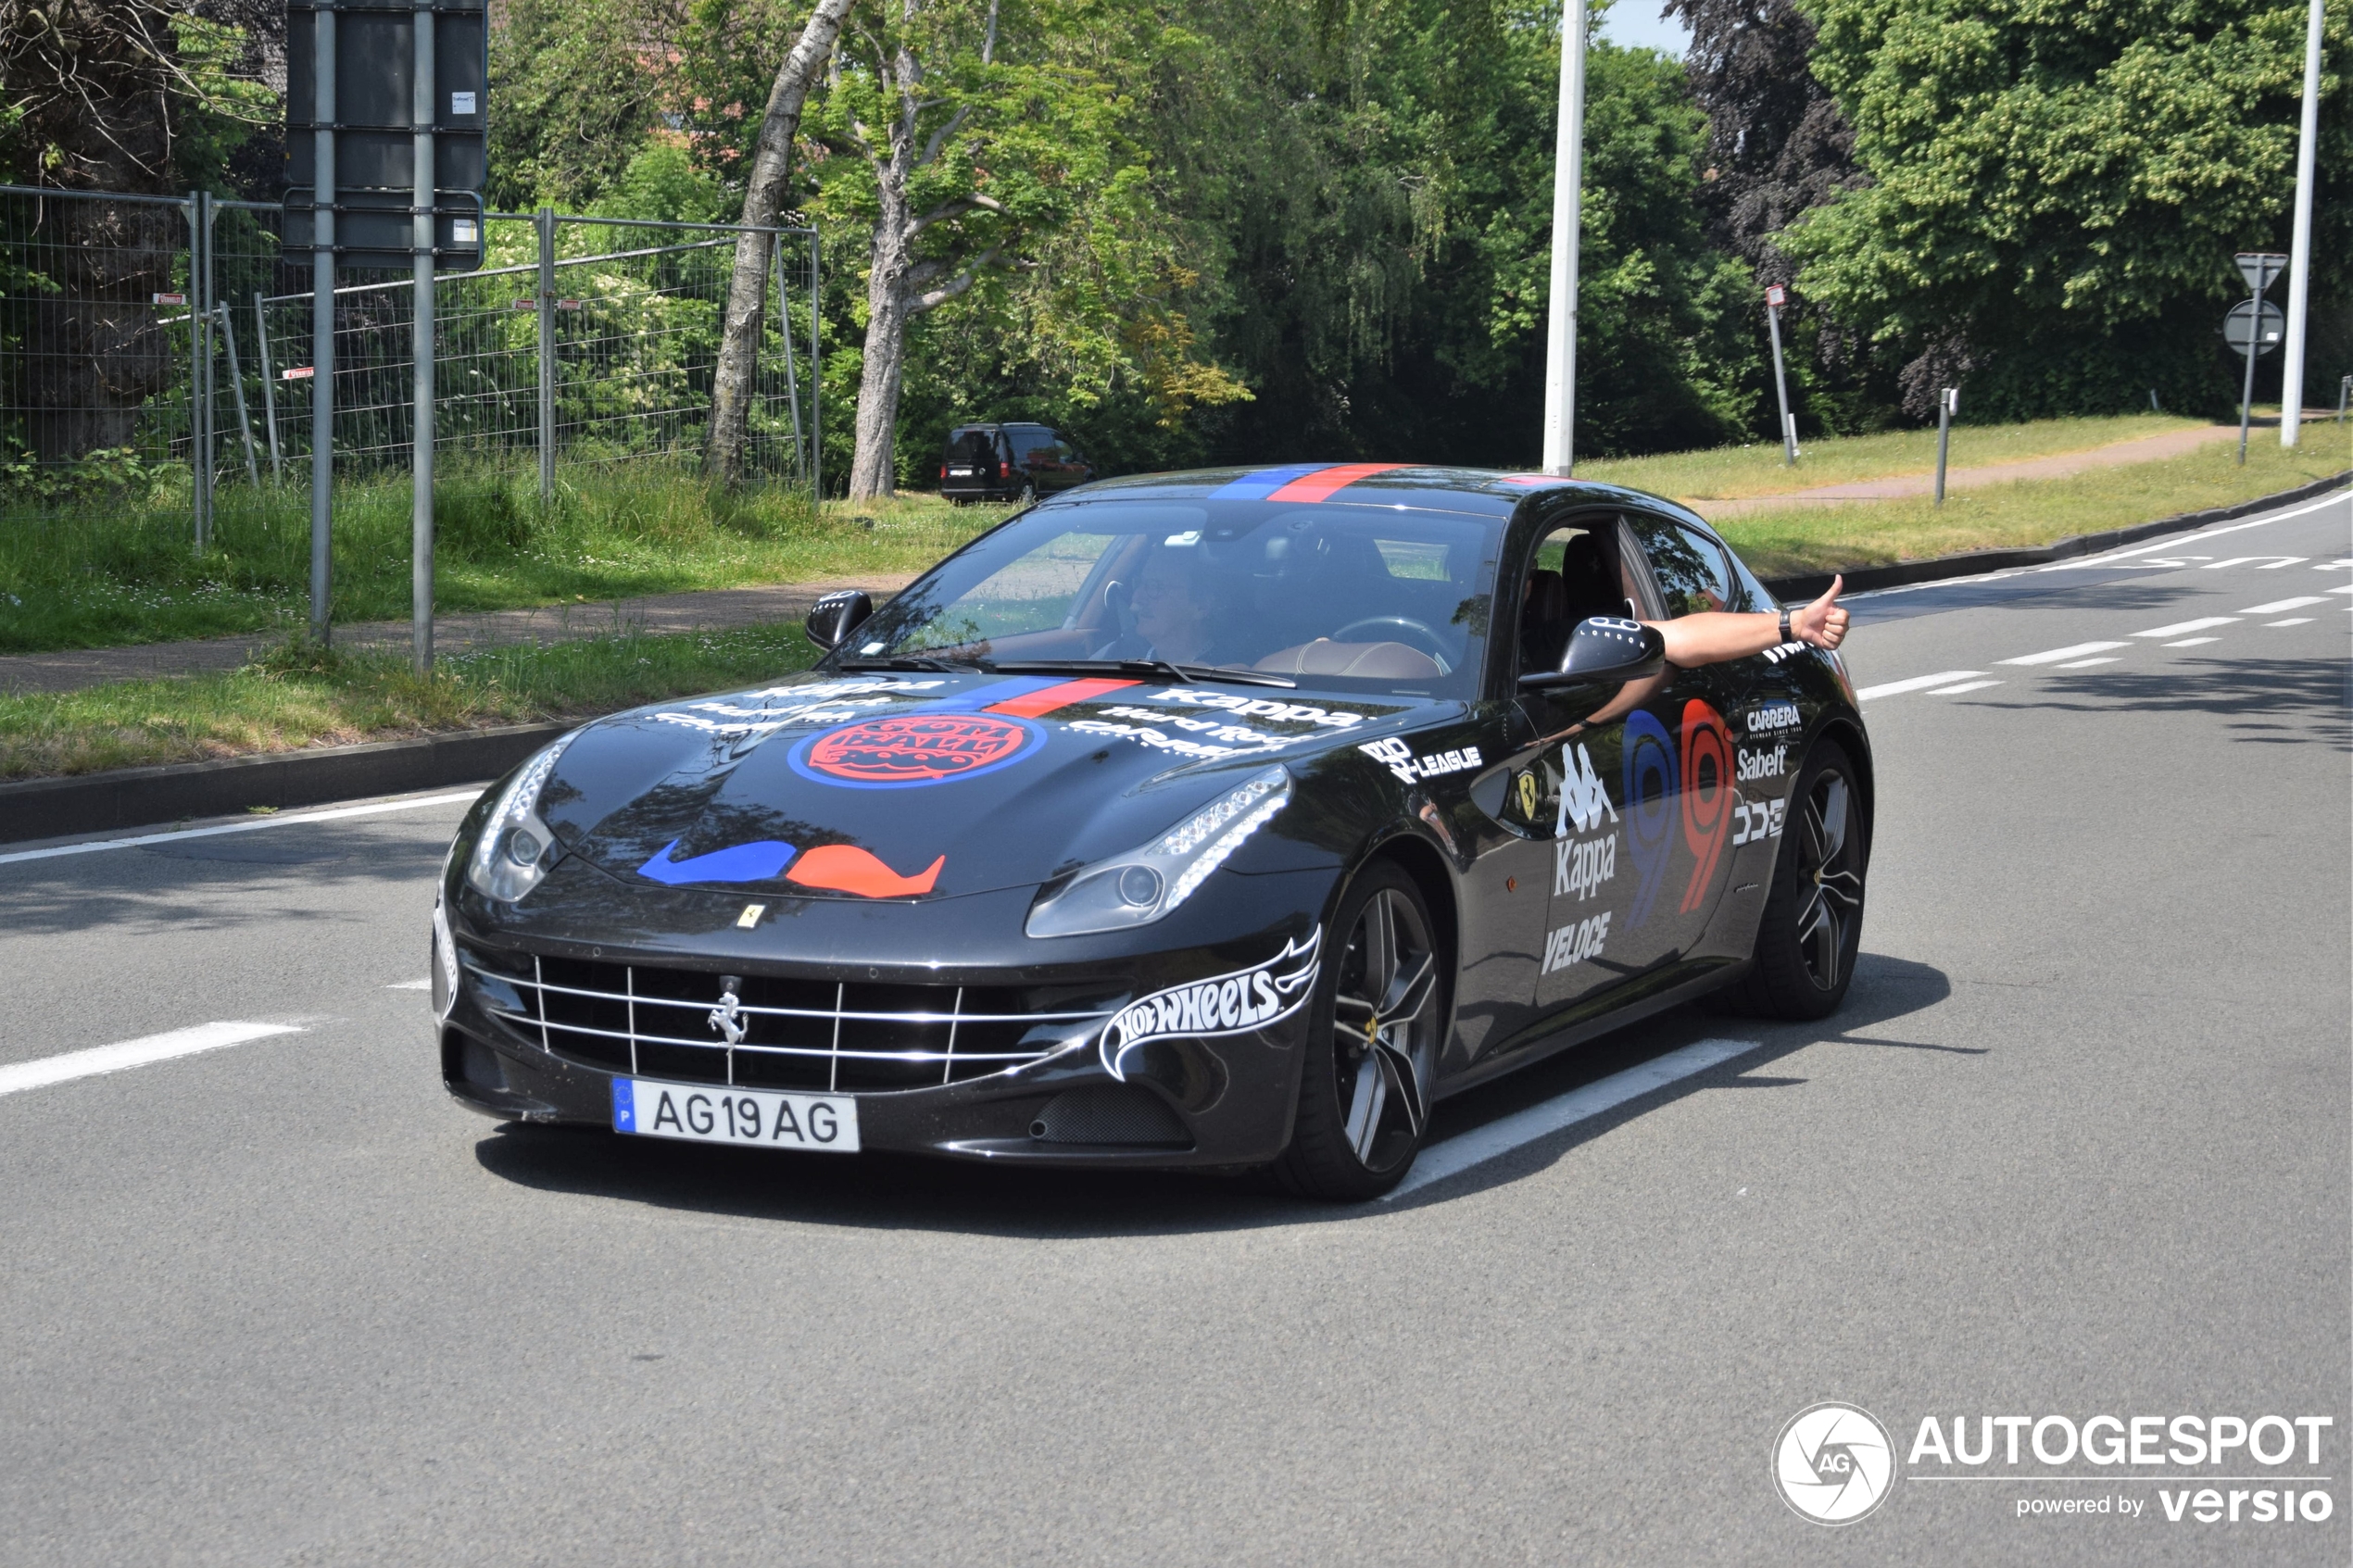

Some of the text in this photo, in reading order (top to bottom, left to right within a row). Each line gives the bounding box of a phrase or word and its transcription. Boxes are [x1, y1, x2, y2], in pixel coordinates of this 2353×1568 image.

[1579, 630, 1645, 649] LONDON
[1097, 706, 1220, 732] Hard
[1147, 688, 1364, 727] Kappa
[1747, 705, 1801, 732] CARRERA
[1737, 745, 1786, 782] Sabelt
[1554, 834, 1616, 901] Kappa
[1541, 910, 1612, 975] VELOCE
[620, 1110, 630, 1123] P
